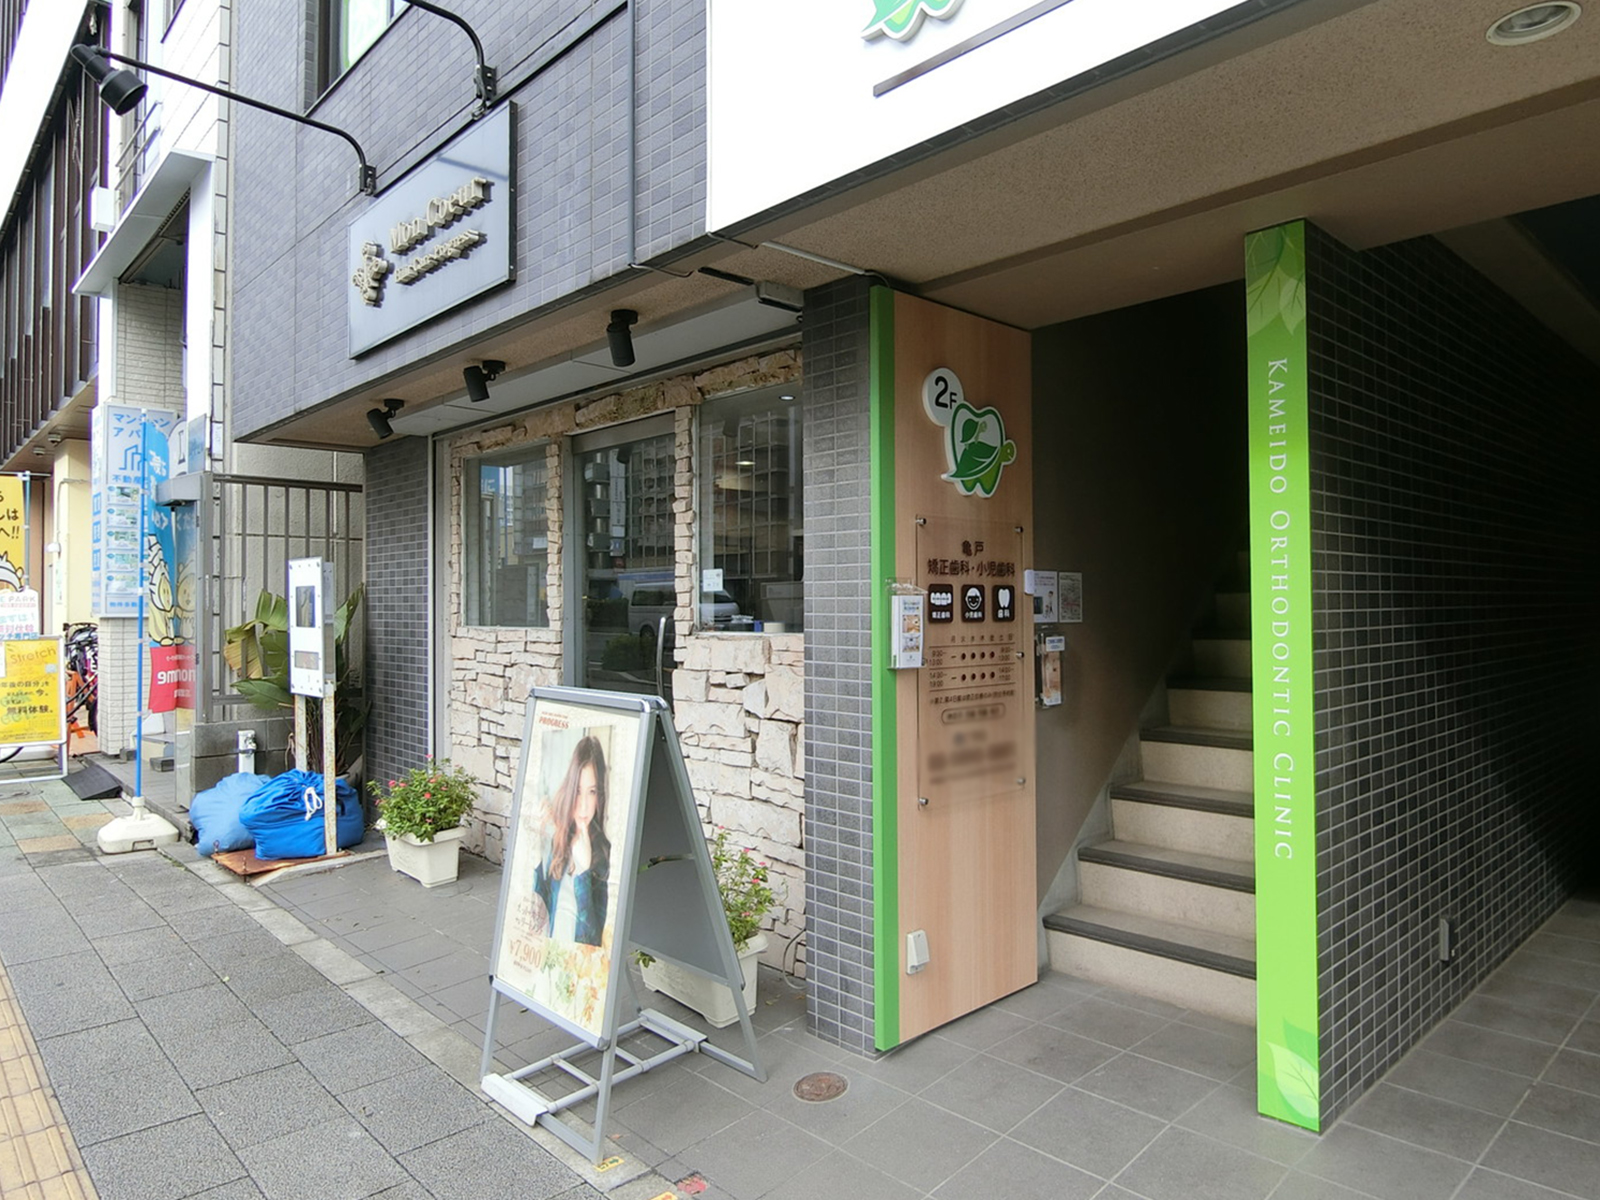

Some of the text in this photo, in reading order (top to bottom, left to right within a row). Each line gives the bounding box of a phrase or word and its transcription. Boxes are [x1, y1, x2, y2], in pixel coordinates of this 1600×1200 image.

[391, 177, 486, 253] Mon Coeur
[934, 375, 958, 409] 2F
[961, 540, 984, 557] 亀戸
[927, 558, 1015, 577] 矯正歯科・小児歯科
[1268, 357, 1293, 860] KAMEIDO ORTHODONTIC CLINIC
[10, 646, 57, 665] Stretch
